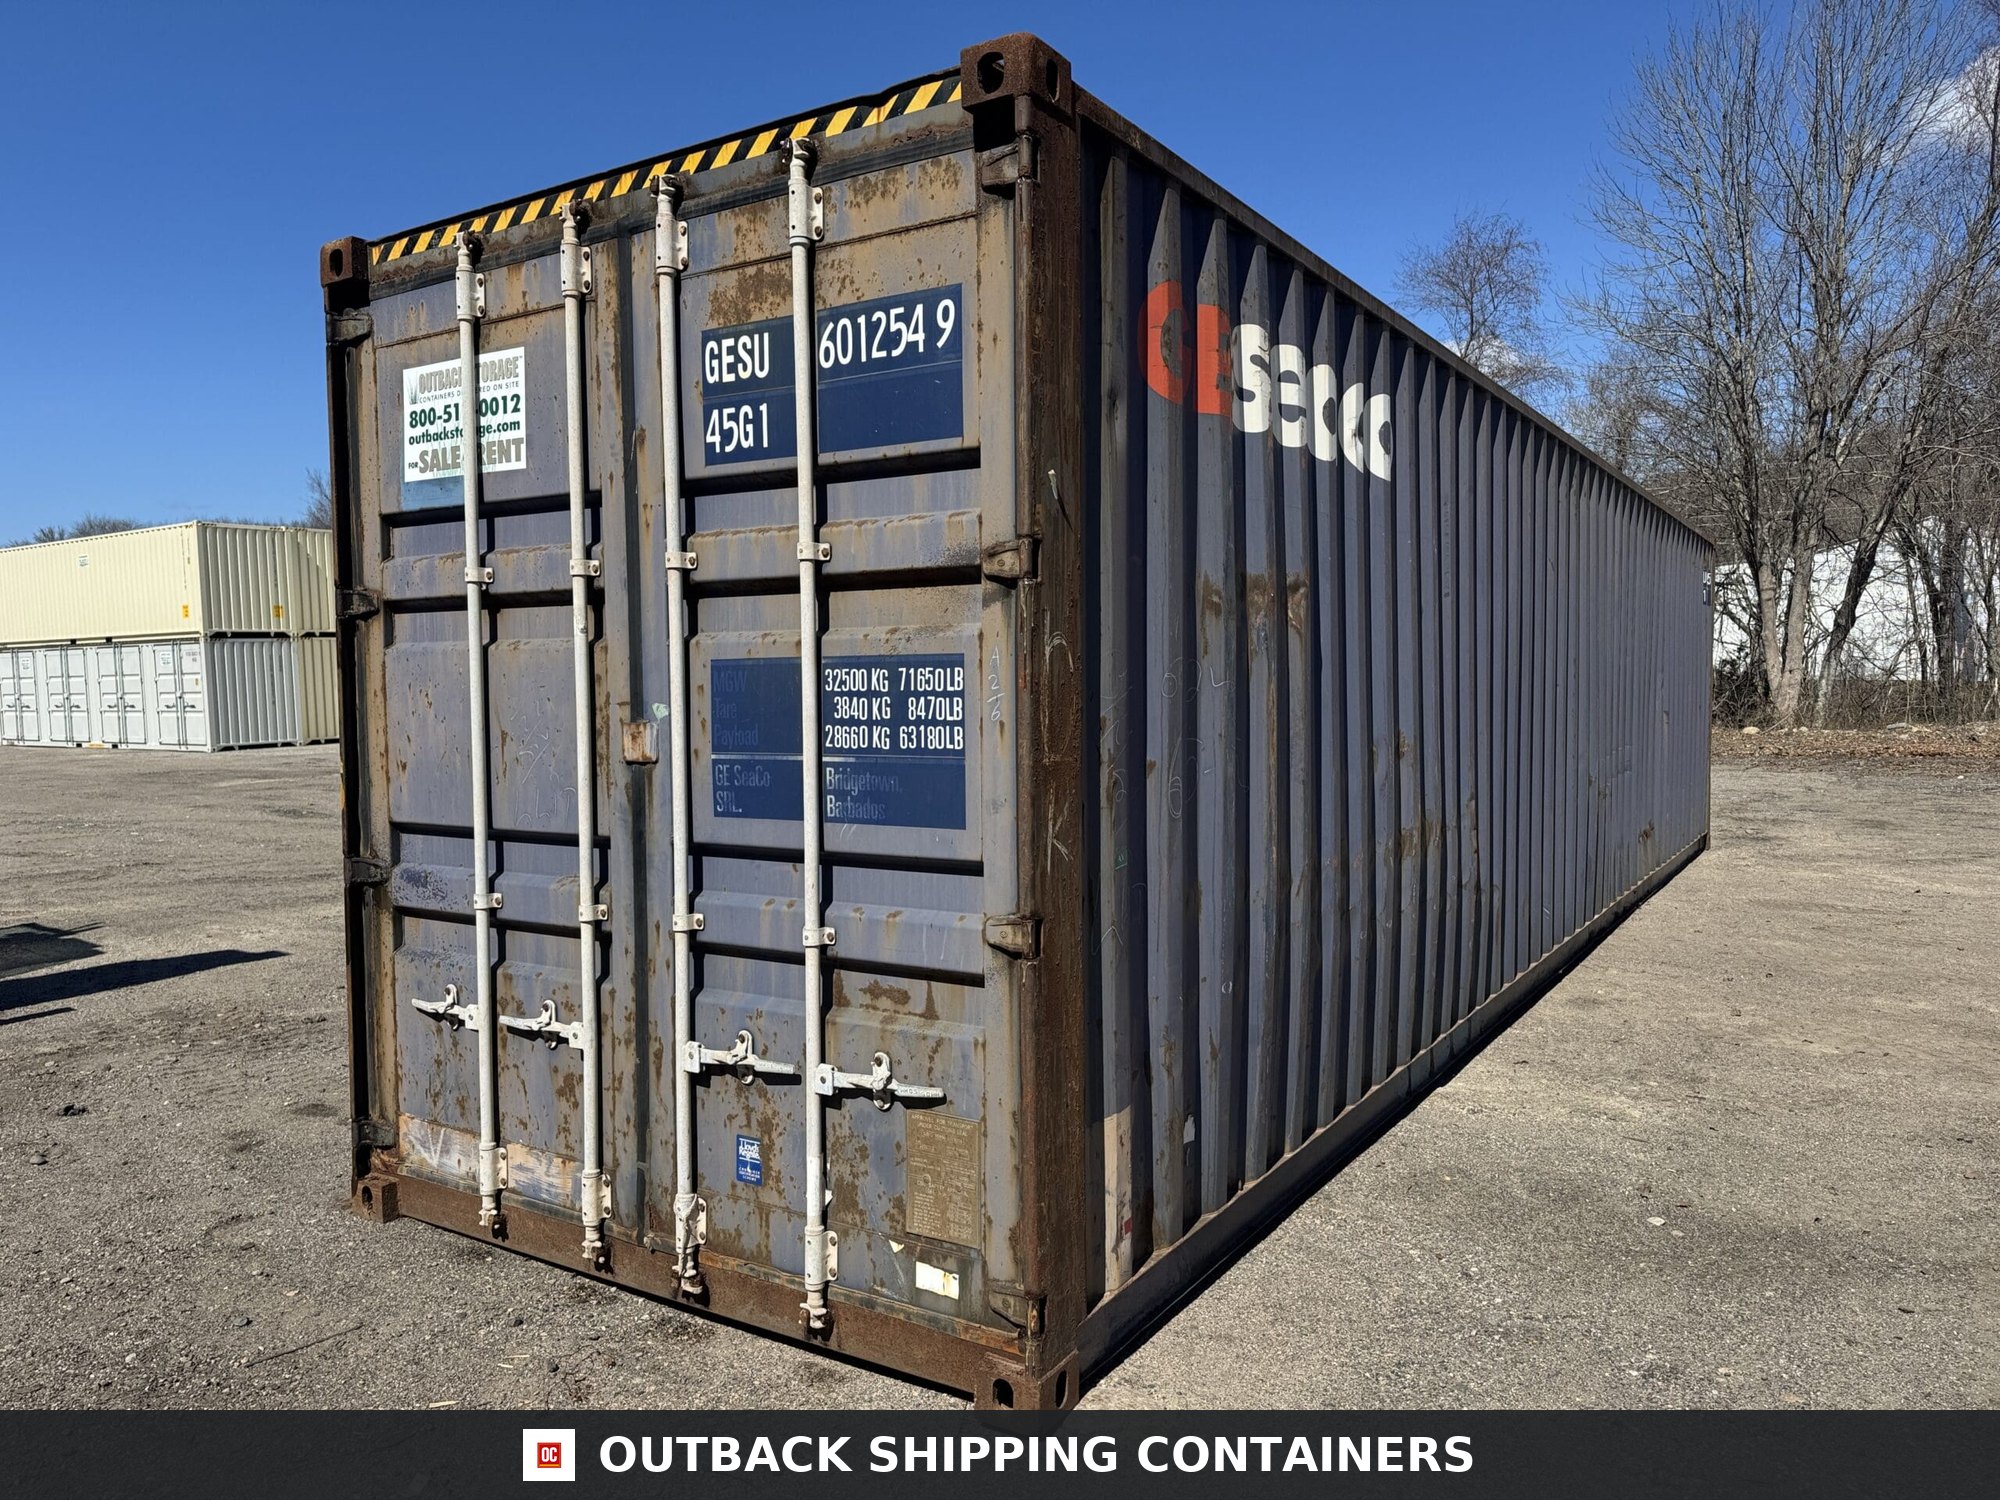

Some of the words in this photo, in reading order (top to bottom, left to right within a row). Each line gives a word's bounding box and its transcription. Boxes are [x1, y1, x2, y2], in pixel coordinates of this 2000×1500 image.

[705, 332, 770, 384] GESU
[819, 303, 925, 369] 601254
[936, 298, 956, 349] 9
[419, 391, 455, 405] CONTAINERS
[493, 383, 503, 392] ON
[505, 380, 520, 390] SITE
[409, 393, 521, 429] 800-51-0012
[705, 402, 769, 454] 45G1
[408, 461, 419, 470] FOR
[825, 668, 867, 692] 32500
[871, 668, 889, 692] KG
[834, 696, 868, 720] 3840
[872, 696, 891, 720] KG
[825, 725, 868, 748] 28660
[872, 725, 890, 750] KG
[715, 764, 731, 786] GE
[734, 765, 771, 787] SeaCo
